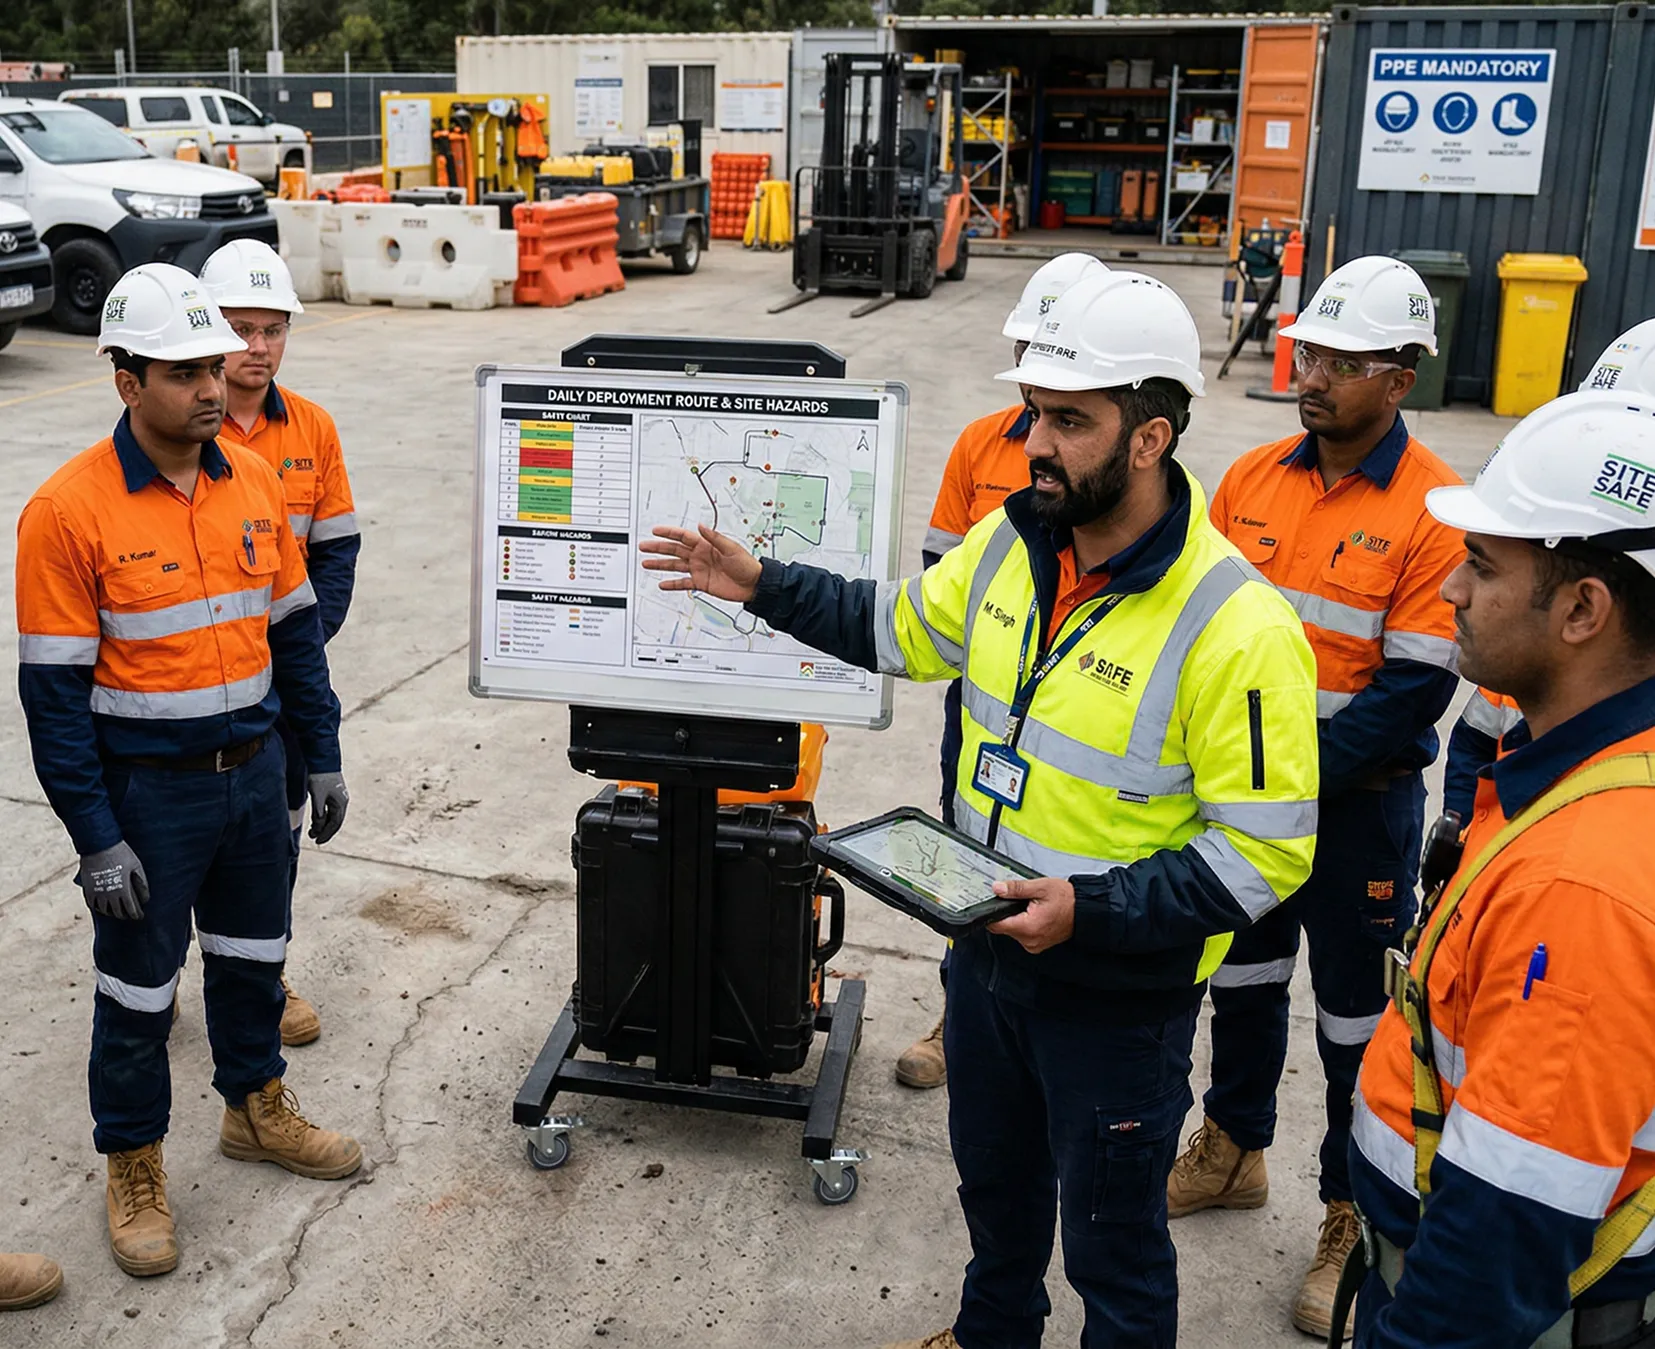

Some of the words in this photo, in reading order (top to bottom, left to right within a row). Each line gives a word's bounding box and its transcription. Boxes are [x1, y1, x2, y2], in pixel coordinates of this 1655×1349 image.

[1380, 60, 1417, 75] PPE
[1422, 60, 1542, 77] MANDATORY
[1595, 366, 1621, 381] SITE
[548, 389, 585, 402] DAILY
[587, 391, 673, 406] DEPLOYMENT
[675, 395, 718, 409] ROUTE
[720, 397, 732, 409] &
[734, 397, 763, 410] SITE
[766, 399, 829, 413] HAZARDS
[1601, 460, 1655, 493] SITE
[1594, 476, 1653, 509] SAFE
[1369, 535, 1392, 552] SITE
[119, 554, 129, 564] R.
[1095, 658, 1134, 687] SAFE
